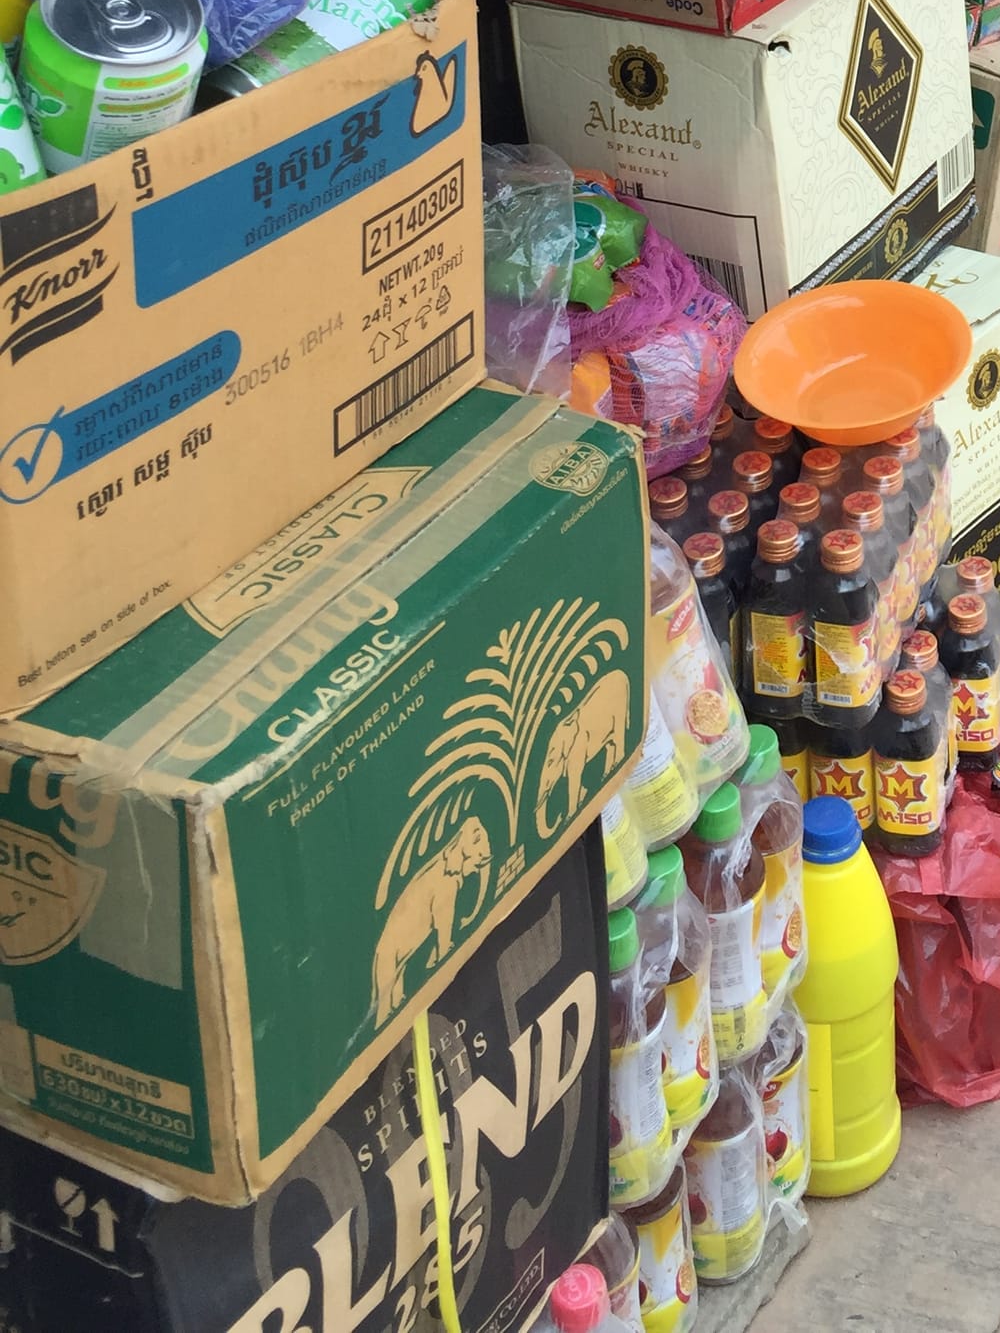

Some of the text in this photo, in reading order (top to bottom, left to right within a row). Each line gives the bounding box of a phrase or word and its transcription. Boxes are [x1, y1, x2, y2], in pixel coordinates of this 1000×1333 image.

[583, 99, 694, 146] Alexand
[856, 57, 910, 123] Alexand
[607, 140, 680, 162] SPECIAL
[617, 161, 670, 178] WHISKY
[369, 175, 458, 259] 21140308
[2, 248, 109, 325] Knorr
[378, 268, 401, 296] NET
[402, 253, 422, 281] WT.
[398, 293, 408, 309] x
[411, 277, 428, 299] 12
[224, 348, 291, 407] 300516
[239, 492, 389, 601] CLASSIC
[17, 666, 43, 688] Best
[46, 643, 77, 670] before
[80, 630, 97, 647] see
[100, 617, 115, 633] on
[116, 602, 137, 623] side
[139, 591, 149, 606] of
[266, 627, 403, 745] CLASSIC
[267, 658, 437, 817] FULL FLAVOURED LAGER
[289, 694, 426, 827] PRIDE OF THAILAND
[886, 777, 916, 799] M
